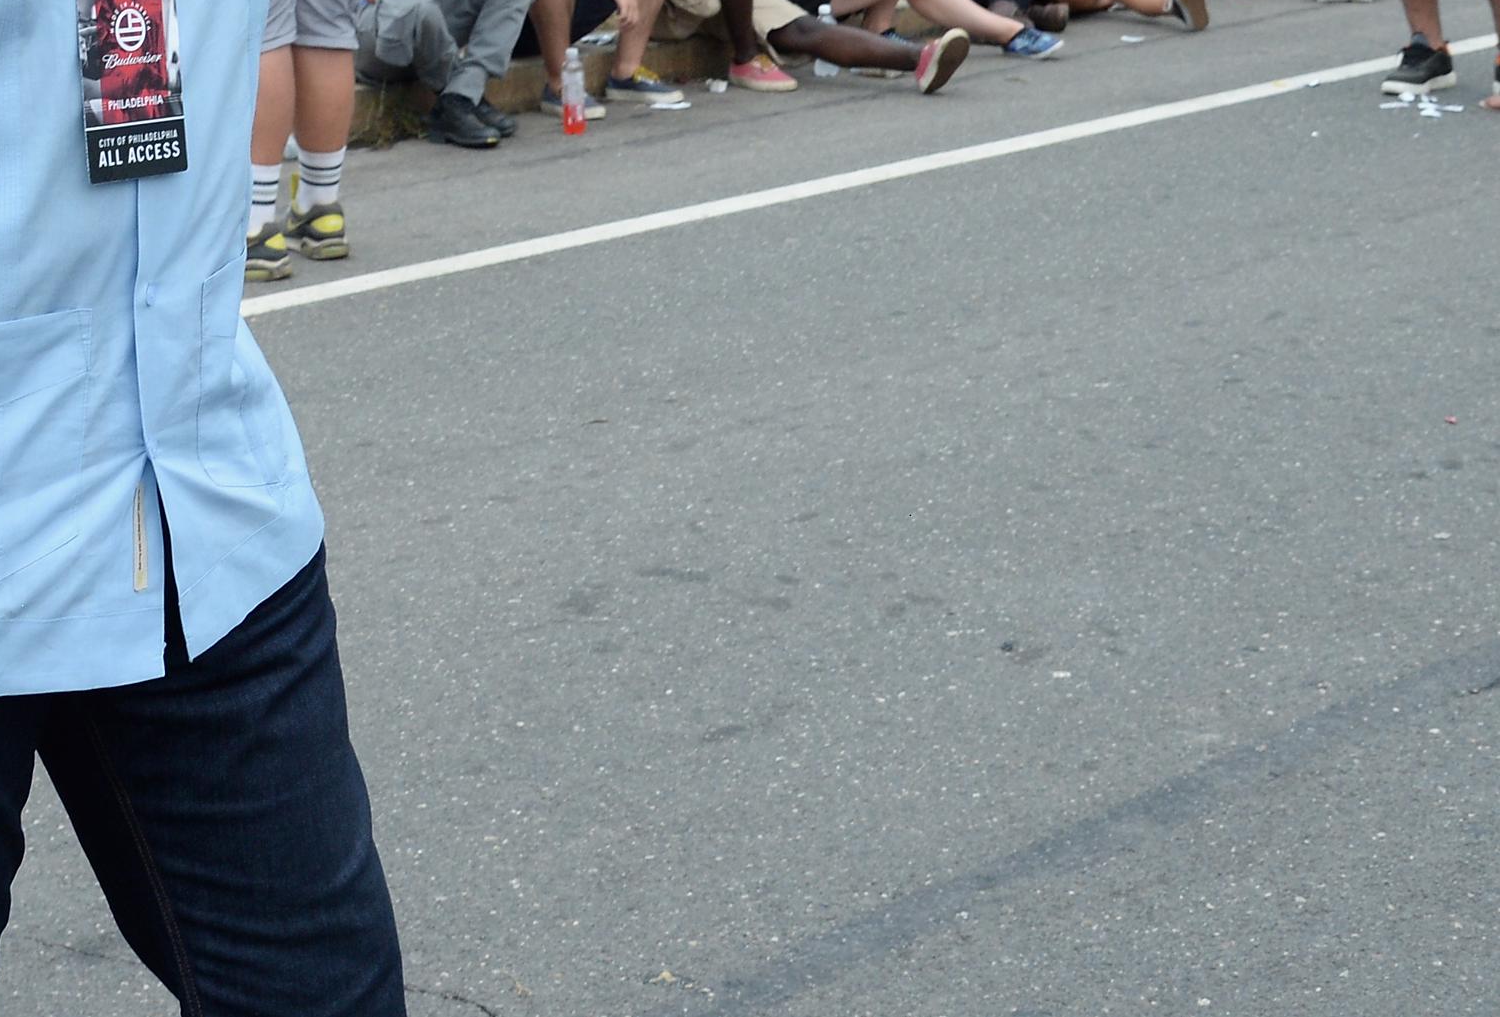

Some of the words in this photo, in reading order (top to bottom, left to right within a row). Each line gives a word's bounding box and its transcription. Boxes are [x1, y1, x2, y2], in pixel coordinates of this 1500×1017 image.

[130, 1, 151, 31] AMERICA
[102, 52, 162, 70] Budweiser
[108, 94, 164, 111] PHILADELPHIA
[98, 137, 115, 149] CITY
[117, 135, 126, 146] OF
[128, 129, 178, 144] PHILADELPHIA
[99, 149, 123, 168] ALL
[128, 140, 180, 164] ACCESS
